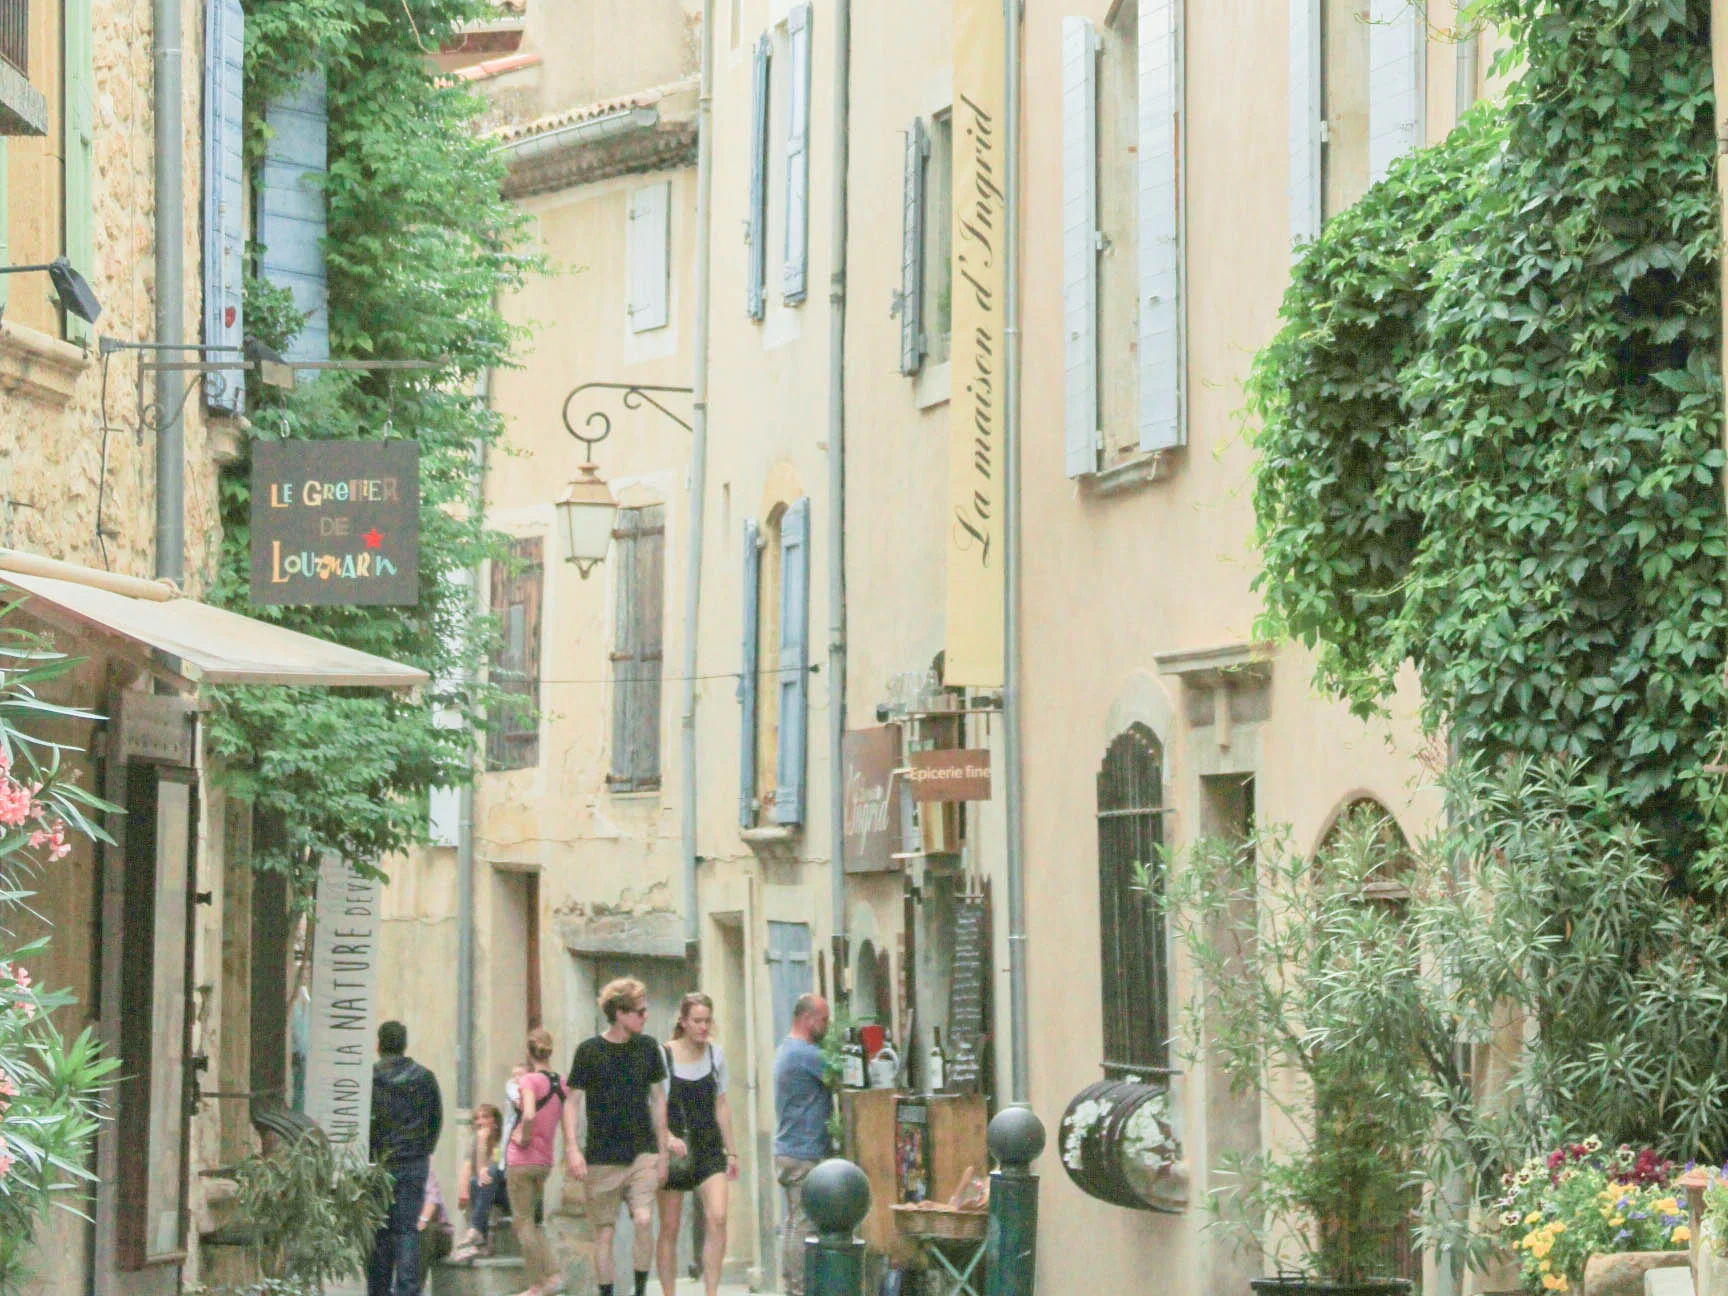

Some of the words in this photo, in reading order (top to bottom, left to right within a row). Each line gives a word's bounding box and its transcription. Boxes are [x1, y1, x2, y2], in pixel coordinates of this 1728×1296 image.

[956, 93, 1004, 312] d'Ingrid
[966, 328, 992, 480] maison
[271, 483, 293, 508] LE
[320, 517, 349, 537] DE
[953, 489, 990, 568] La
[965, 765, 992, 779] fine
[329, 929, 373, 1030] NATURE
[333, 1045, 363, 1065] LA
[327, 1078, 360, 1143] QUAND
